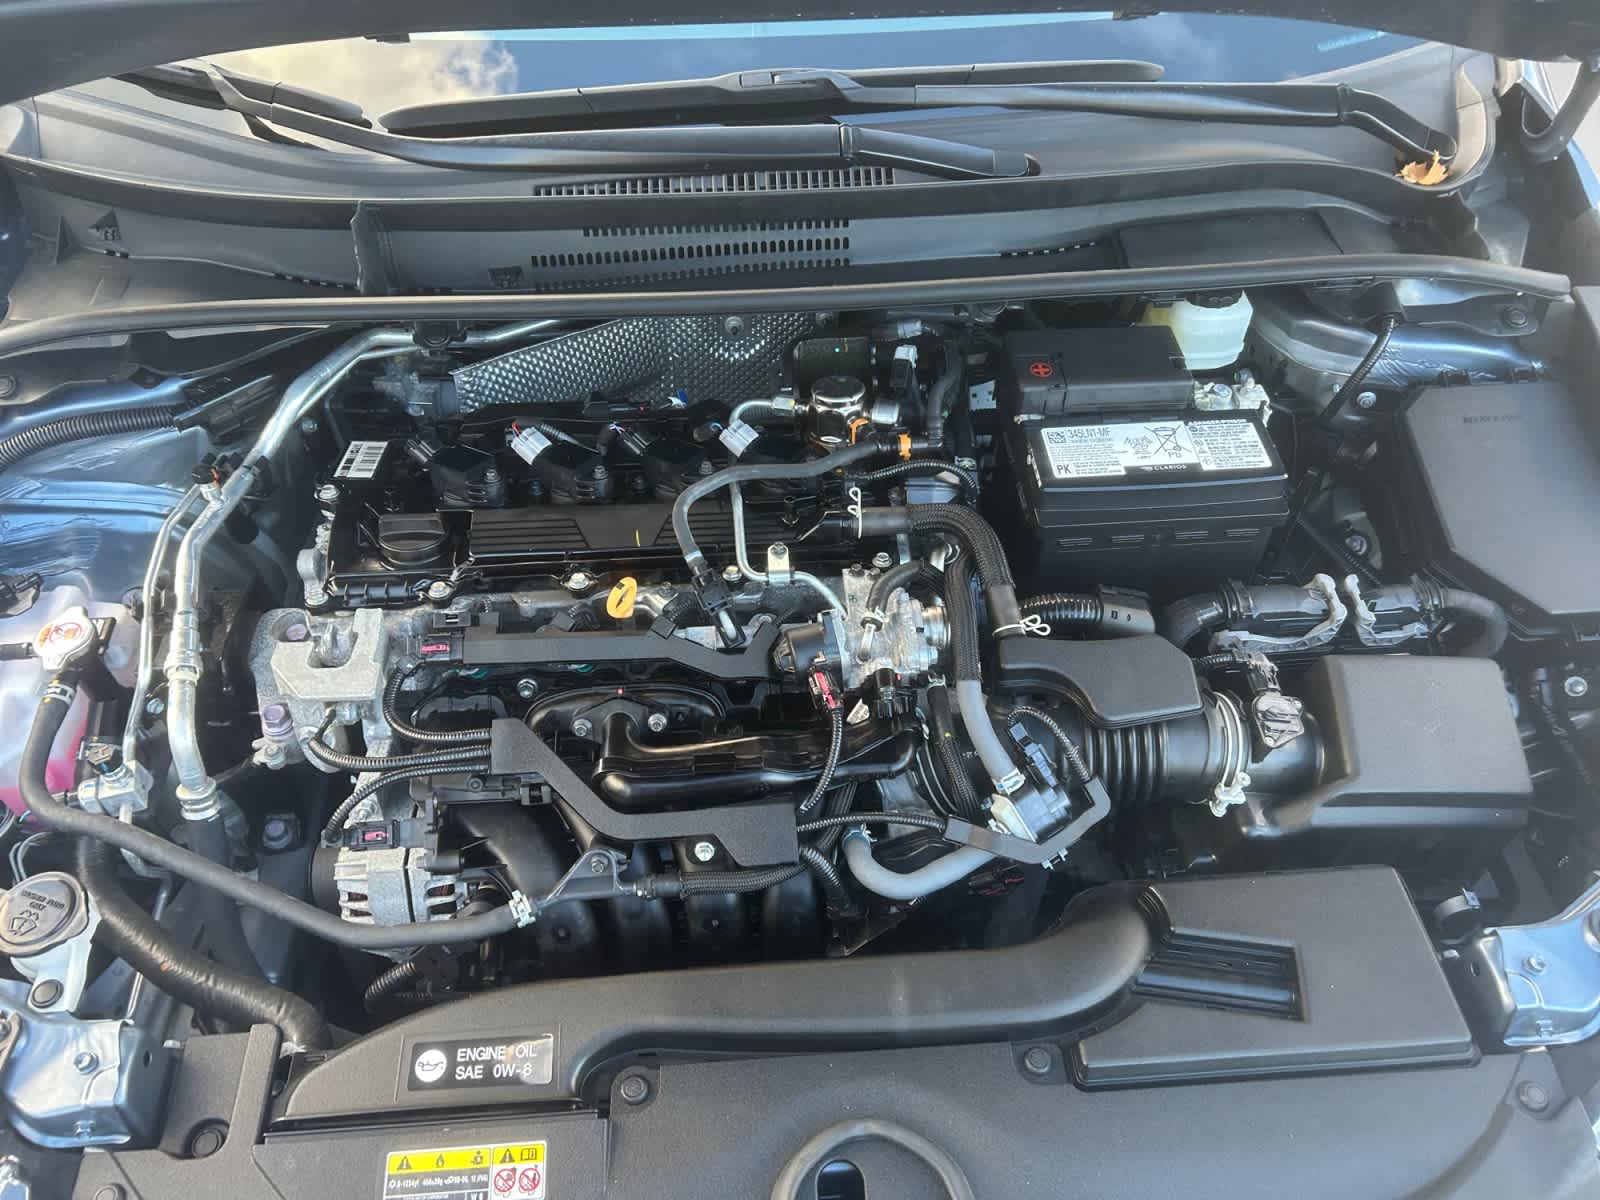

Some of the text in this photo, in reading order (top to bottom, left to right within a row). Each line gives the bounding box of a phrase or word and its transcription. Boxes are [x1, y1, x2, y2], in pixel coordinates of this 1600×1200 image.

[1056, 464, 1071, 474] PK
[456, 1044, 537, 1062] ENGINE OIL
[455, 1062, 533, 1080] SAE 0W-8
